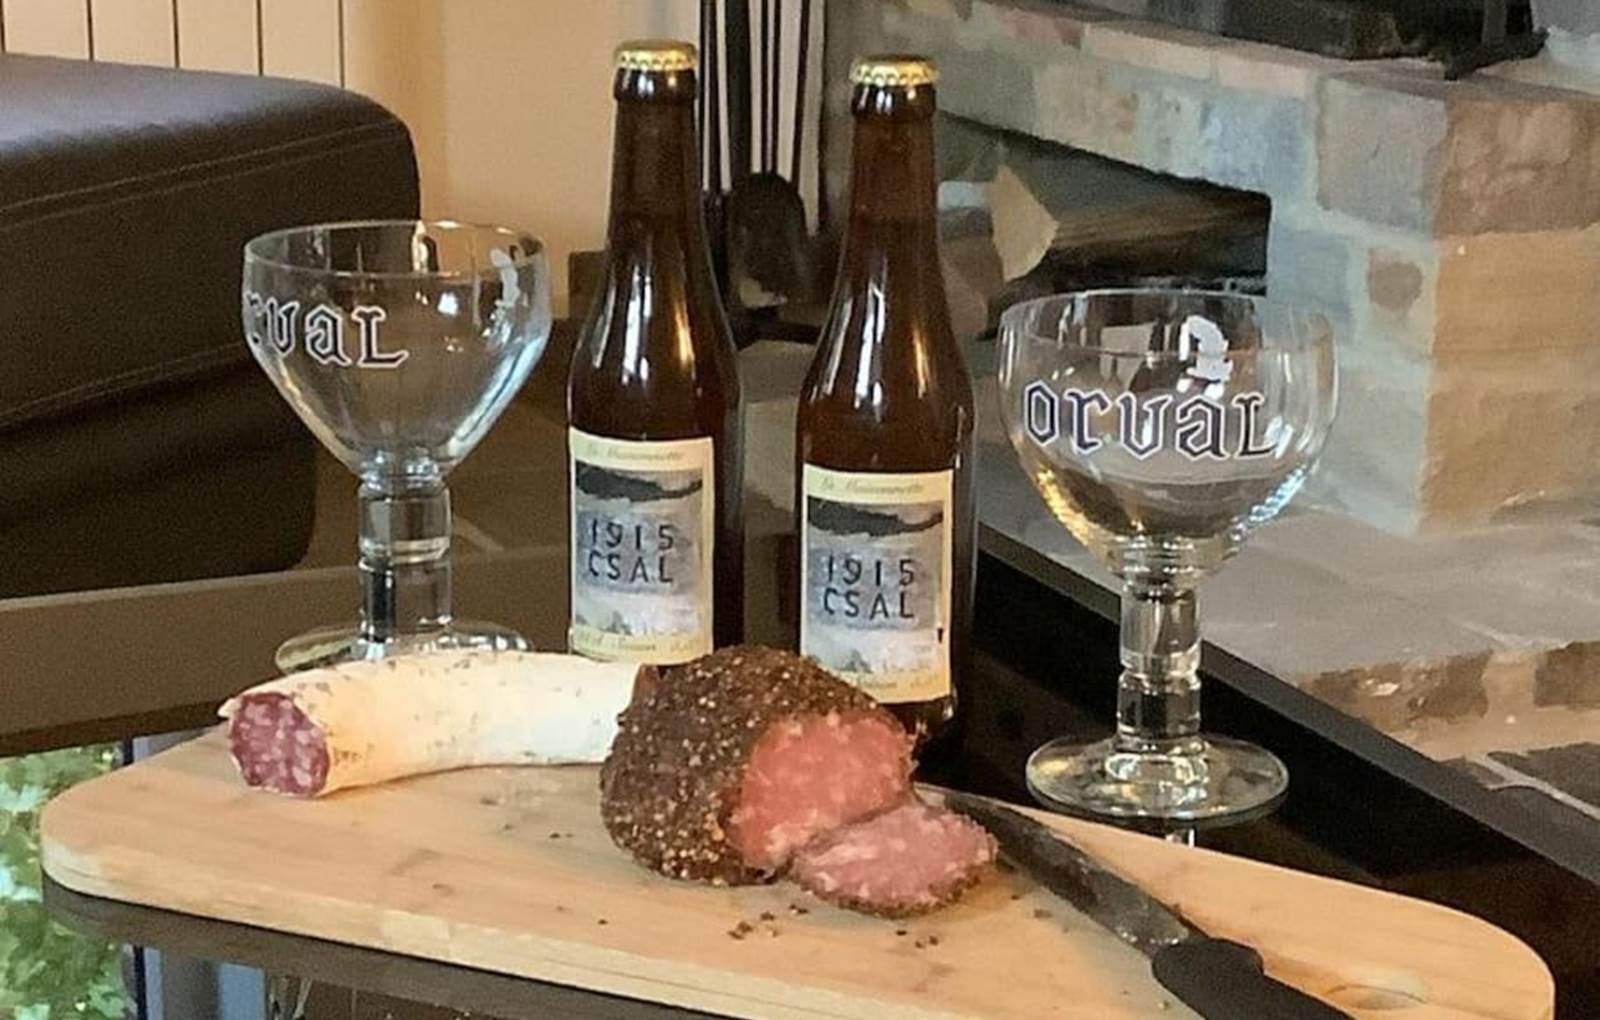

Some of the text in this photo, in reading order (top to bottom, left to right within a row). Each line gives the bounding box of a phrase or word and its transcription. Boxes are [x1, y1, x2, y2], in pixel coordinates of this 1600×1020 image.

[592, 518, 674, 549] 1915
[588, 550, 674, 583] CSAL
[828, 556, 915, 586] 1915
[823, 587, 915, 620] CSAL
